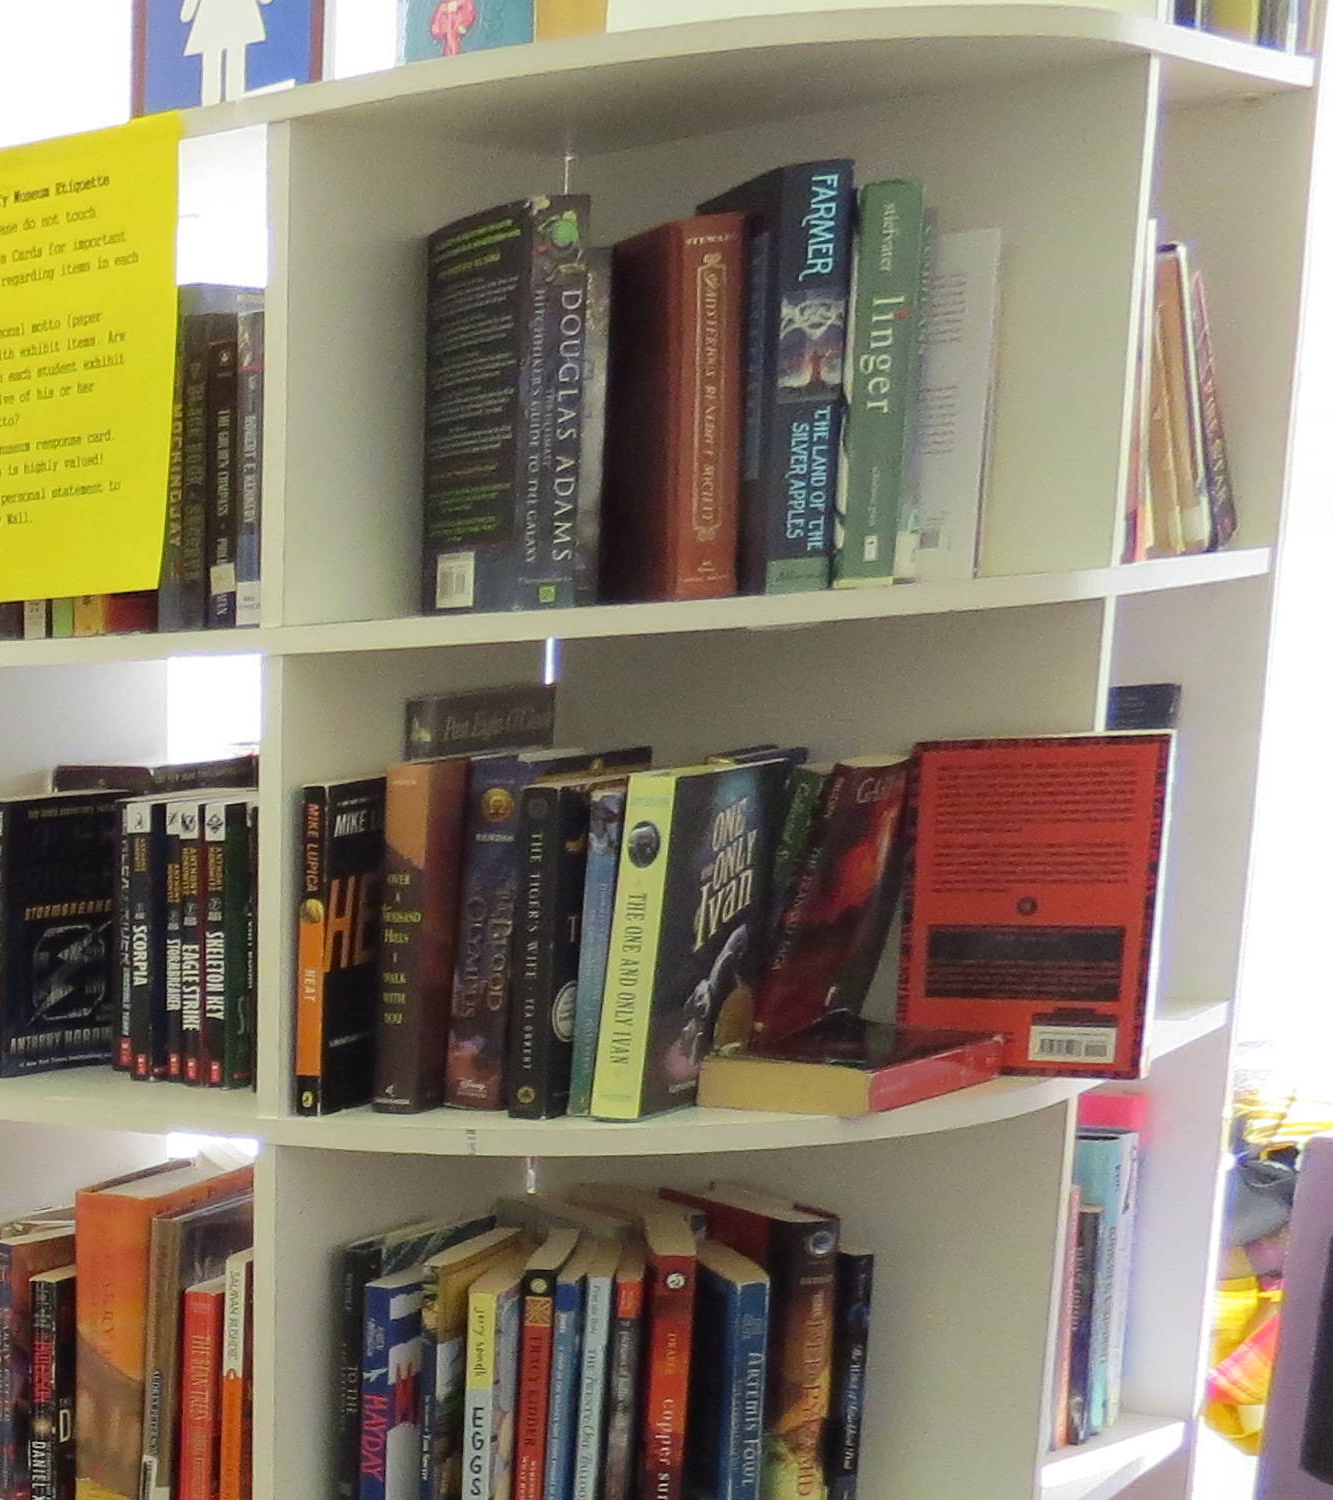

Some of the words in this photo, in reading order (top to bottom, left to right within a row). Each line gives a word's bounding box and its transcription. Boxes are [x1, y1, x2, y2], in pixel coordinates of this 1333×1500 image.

[14, 187, 50, 204] Museum
[55, 175, 110, 197] Etiquette
[23, 218, 36, 230] do
[41, 214, 60, 227] not
[797, 174, 838, 281] FARMER
[12, 246, 43, 263] Cards
[49, 242, 66, 256] for
[73, 231, 127, 250] important
[1, 267, 54, 288] regarding
[61, 262, 91, 277] items
[97, 256, 109, 270] in
[114, 251, 139, 265] each
[31, 318, 61, 334] motto
[67, 312, 102, 329] (paper
[20, 340, 60, 359] exhibit
[66, 335, 100, 352] items.
[108, 331, 126, 344] Are
[860, 295, 911, 415] linger
[8, 368, 32, 383] each
[37, 361, 78, 379] student
[83, 354, 125, 370] exhibit
[557, 289, 583, 441] DOUGLAS
[19, 388, 32, 403] of
[36, 386, 54, 401] his
[59, 385, 72, 396] or
[77, 380, 95, 395] her
[35, 434, 82, 451] response
[87, 429, 115, 444] card.
[812, 405, 831, 442] THE
[8, 464, 18, 476] is
[23, 457, 59, 475] highly
[64, 452, 104, 469] valued!
[527, 455, 540, 473] TO
[786, 422, 809, 477] SILVER
[810, 446, 827, 487] LAND
[1, 488, 46, 507] personal
[51, 483, 102, 498] statement
[108, 479, 121, 492] to
[552, 455, 576, 562] ADAMS
[786, 479, 807, 539] APPLES
[810, 490, 826, 511] OF
[6, 511, 33, 525] Wall.
[806, 515, 825, 551] THE
[307, 803, 320, 839] MIKE
[712, 796, 748, 852] ONE
[306, 843, 319, 892] LUPICA
[713, 828, 758, 890] ONLY
[528, 872, 541, 933] TIGER'S
[626, 893, 647, 921] THE
[133, 925, 148, 986] SCORPIA
[622, 926, 643, 953] ONE
[166, 939, 181, 1011] STORMBREAKER
[182, 944, 199, 983] EAGLE
[205, 931, 224, 991] SKELETON
[524, 940, 538, 980] WIFE
[619, 959, 638, 987] AND
[303, 968, 317, 1002] HEAT
[182, 985, 200, 1032] STRIKE
[205, 996, 223, 1020] KEY
[614, 992, 636, 1027] ONLY
[610, 1032, 632, 1065] IVAN
[190, 1334, 211, 1356] THE
[189, 1389, 210, 1421] TREES
[362, 1394, 388, 1483] MAYDAY
[655, 1398, 674, 1465] copper
[796, 1385, 824, 1497] PYRAMID
[31, 1441, 46, 1489] DANIEL
[470, 1407, 485, 1497] EGGS
